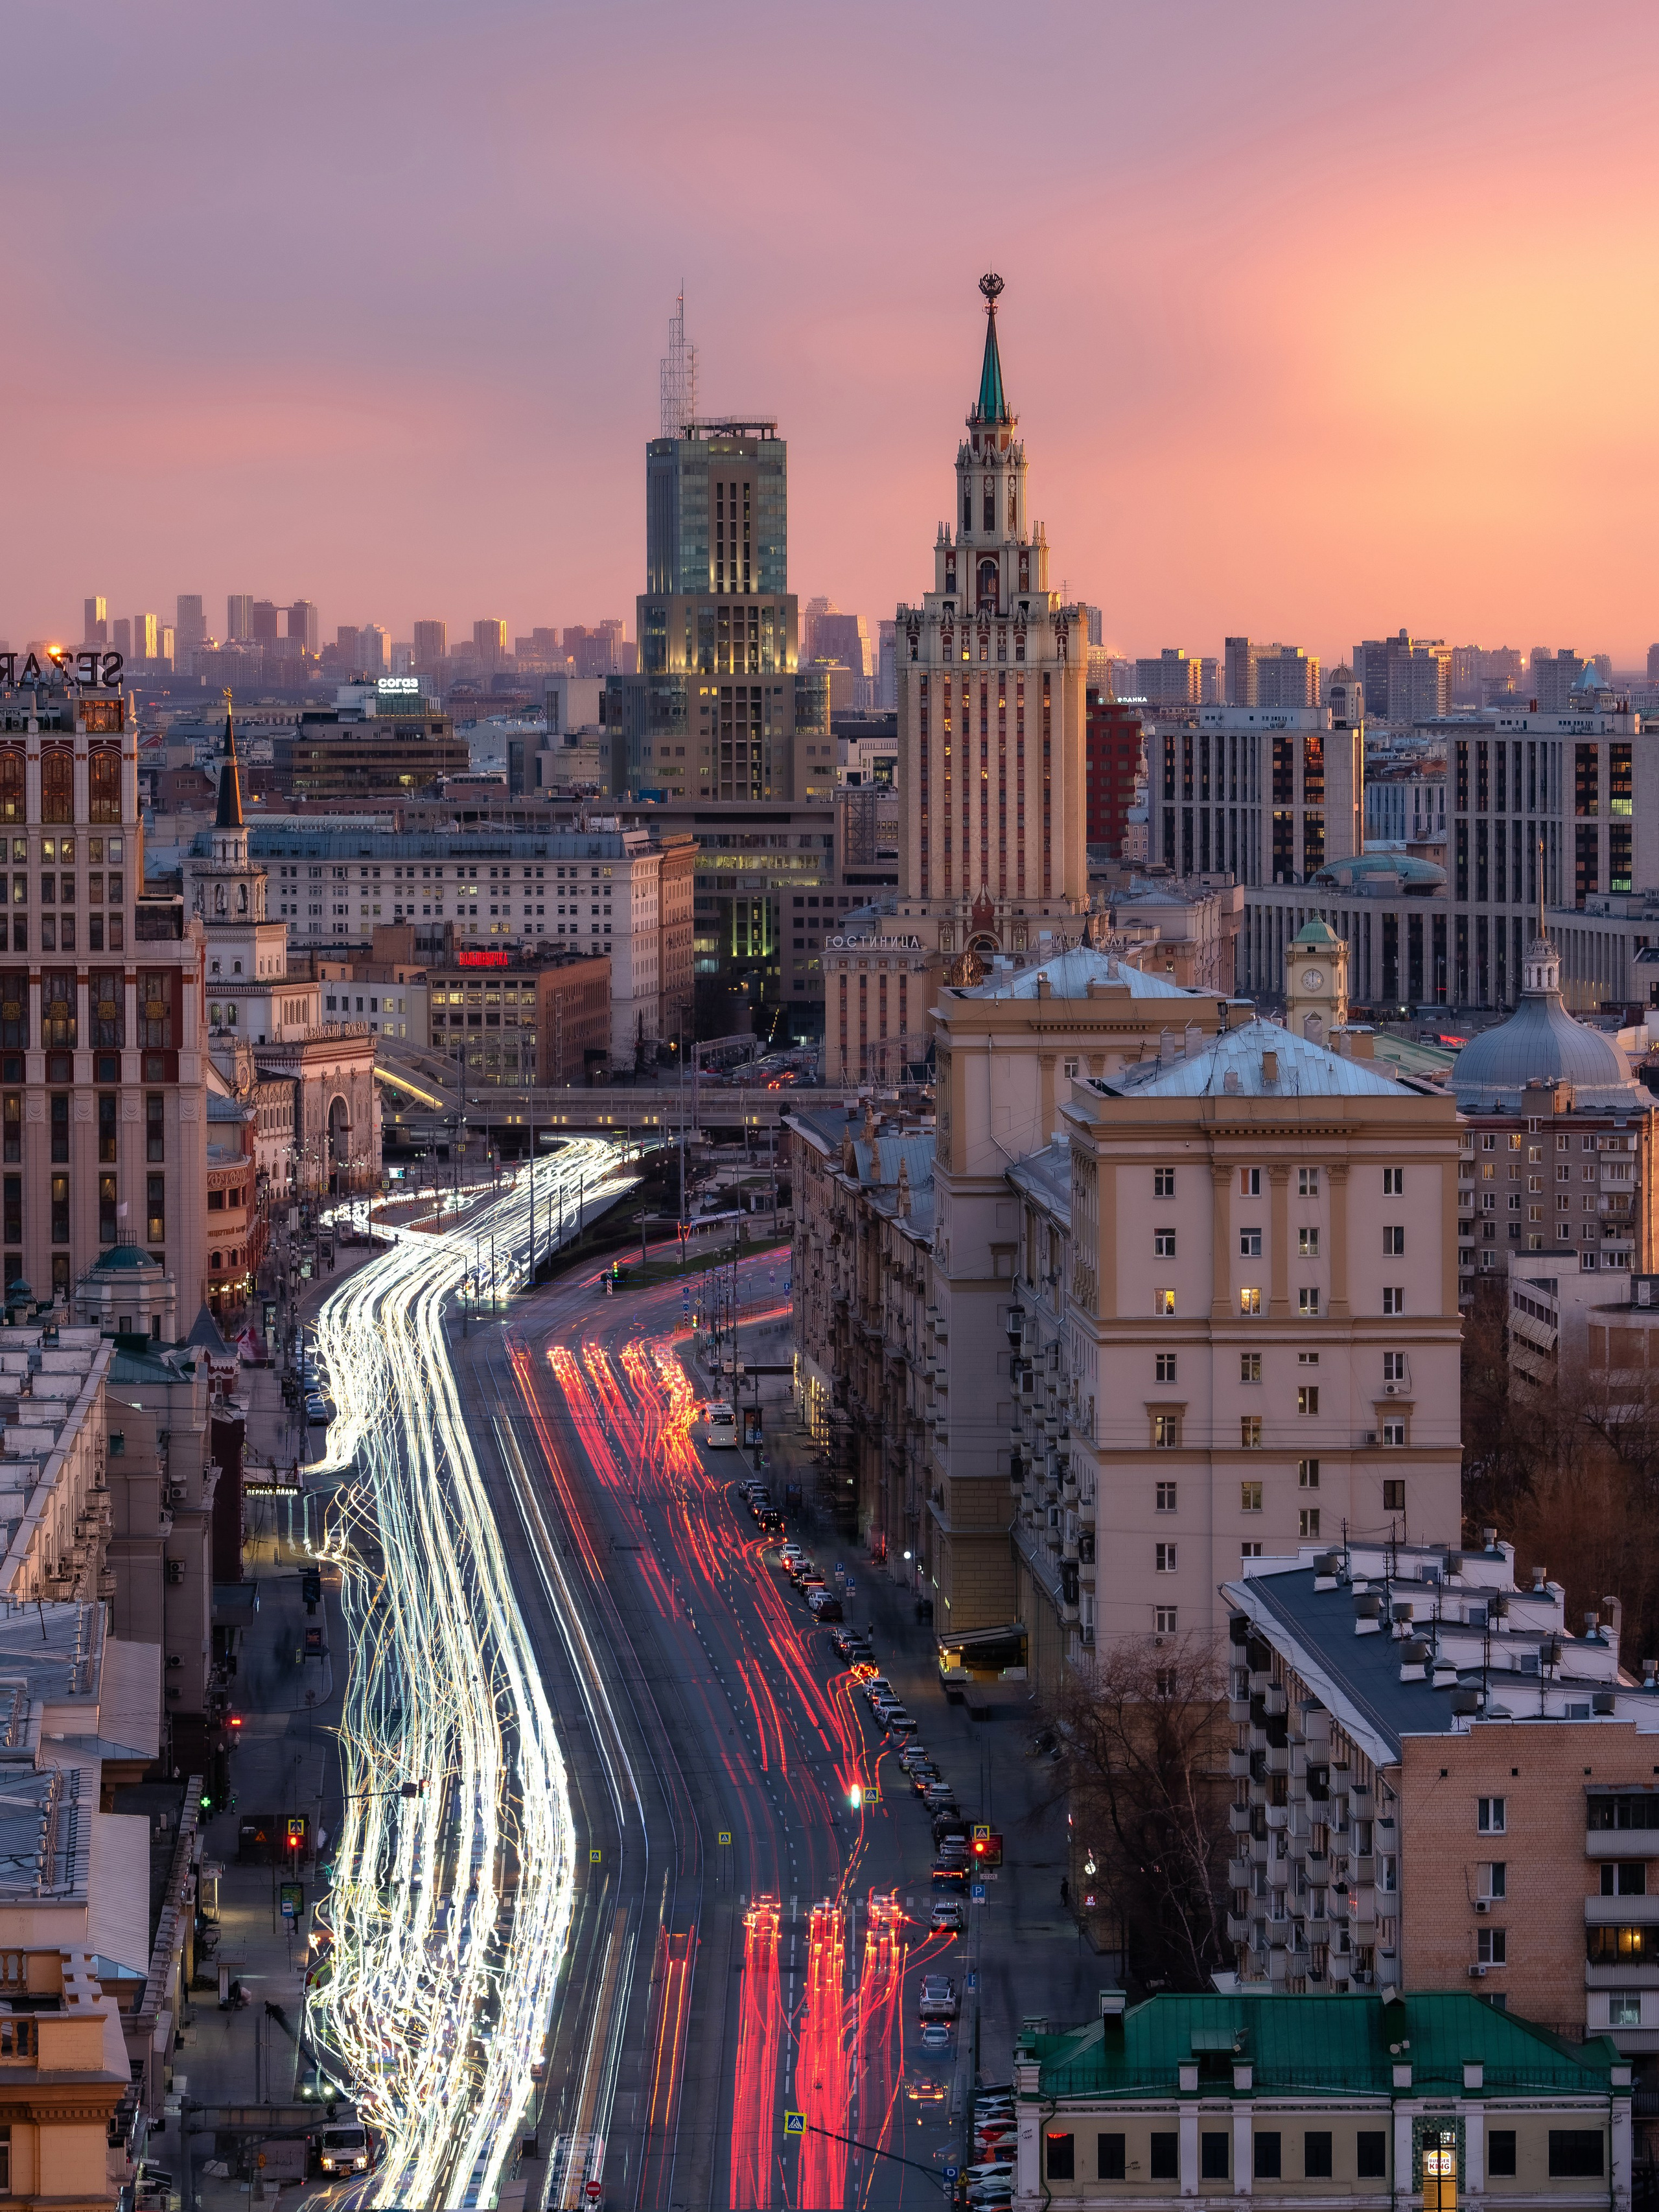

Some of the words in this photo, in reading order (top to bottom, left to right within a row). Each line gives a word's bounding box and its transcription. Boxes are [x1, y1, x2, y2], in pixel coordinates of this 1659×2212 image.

[826, 935, 919, 948] ГОСТИНИЦА
[1030, 935, 1124, 948] ЛИНГРСКАЯ
[459, 951, 508, 966] БОЛЬШЕВИЧКА
[303, 1022, 341, 1040] КАЗАНСКИЙ
[345, 1021, 368, 1036] ВОКЗАЛ
[975, 1887, 982, 1896] P
